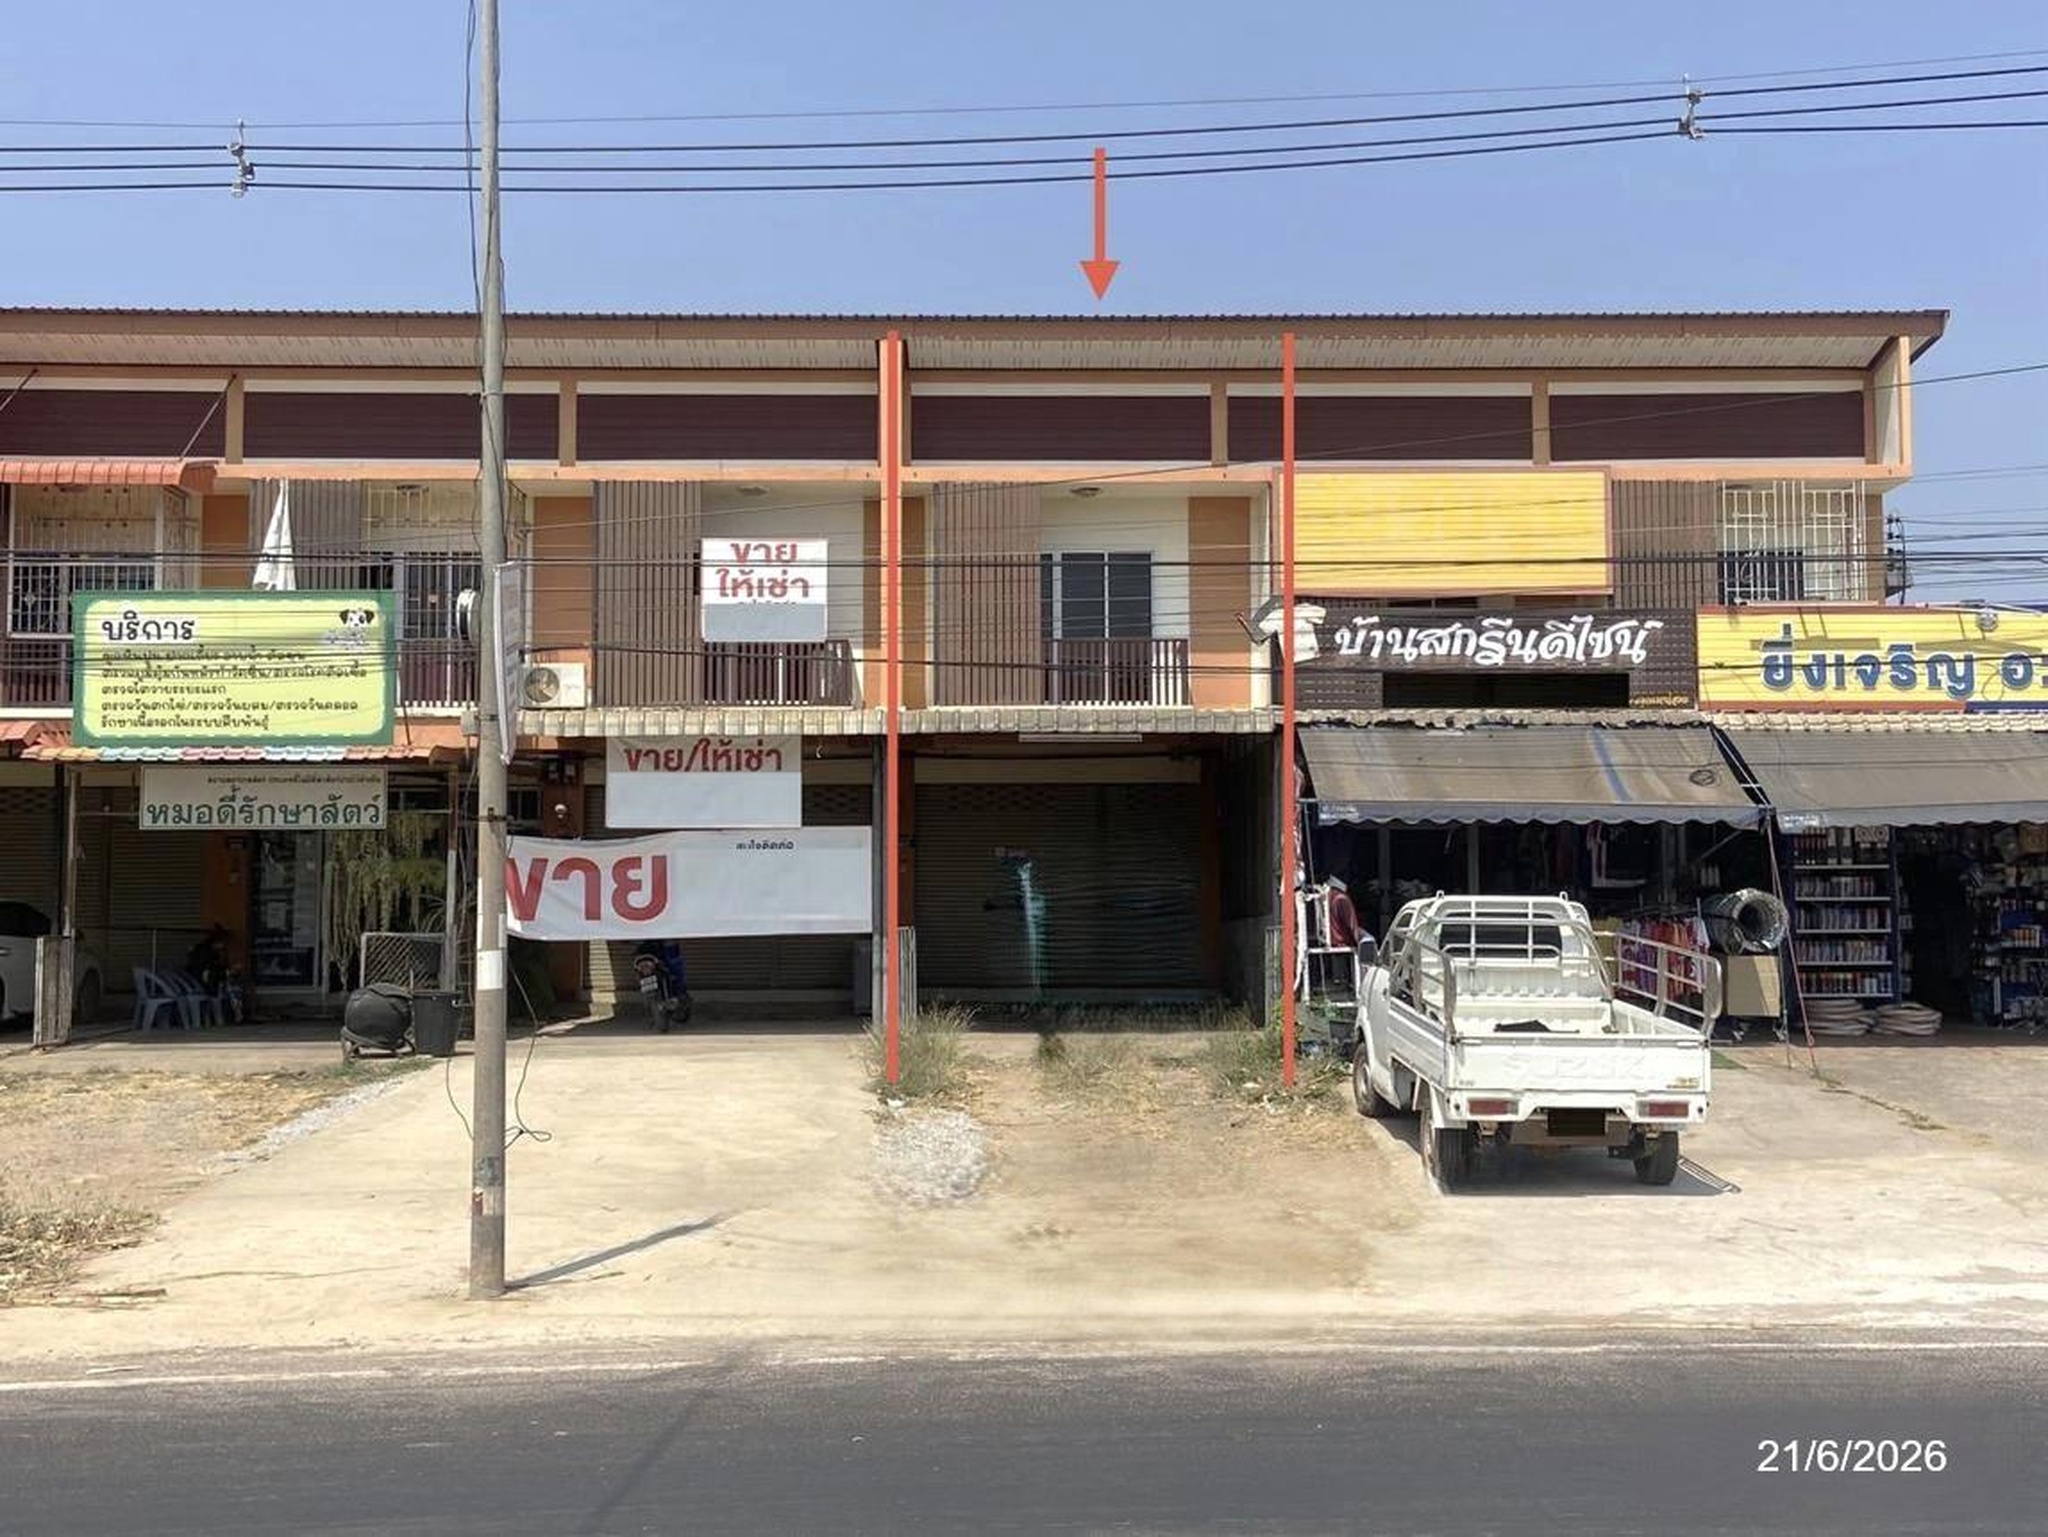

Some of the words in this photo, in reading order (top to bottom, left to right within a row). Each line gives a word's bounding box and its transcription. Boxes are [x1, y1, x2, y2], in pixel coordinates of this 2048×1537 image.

[730, 543, 797, 563] ขาย
[716, 568, 809, 598] ให้เช่า
[102, 611, 195, 641] บริการ
[1335, 614, 1664, 667] บ้านสกรีนดีไซน์
[1761, 623, 1977, 699] ยิ่งเจริญ
[624, 738, 782, 772] ขาย/ให้เช่า
[147, 786, 380, 826] หมอดี้รักษาสัตว์
[506, 855, 668, 922] ขาย
